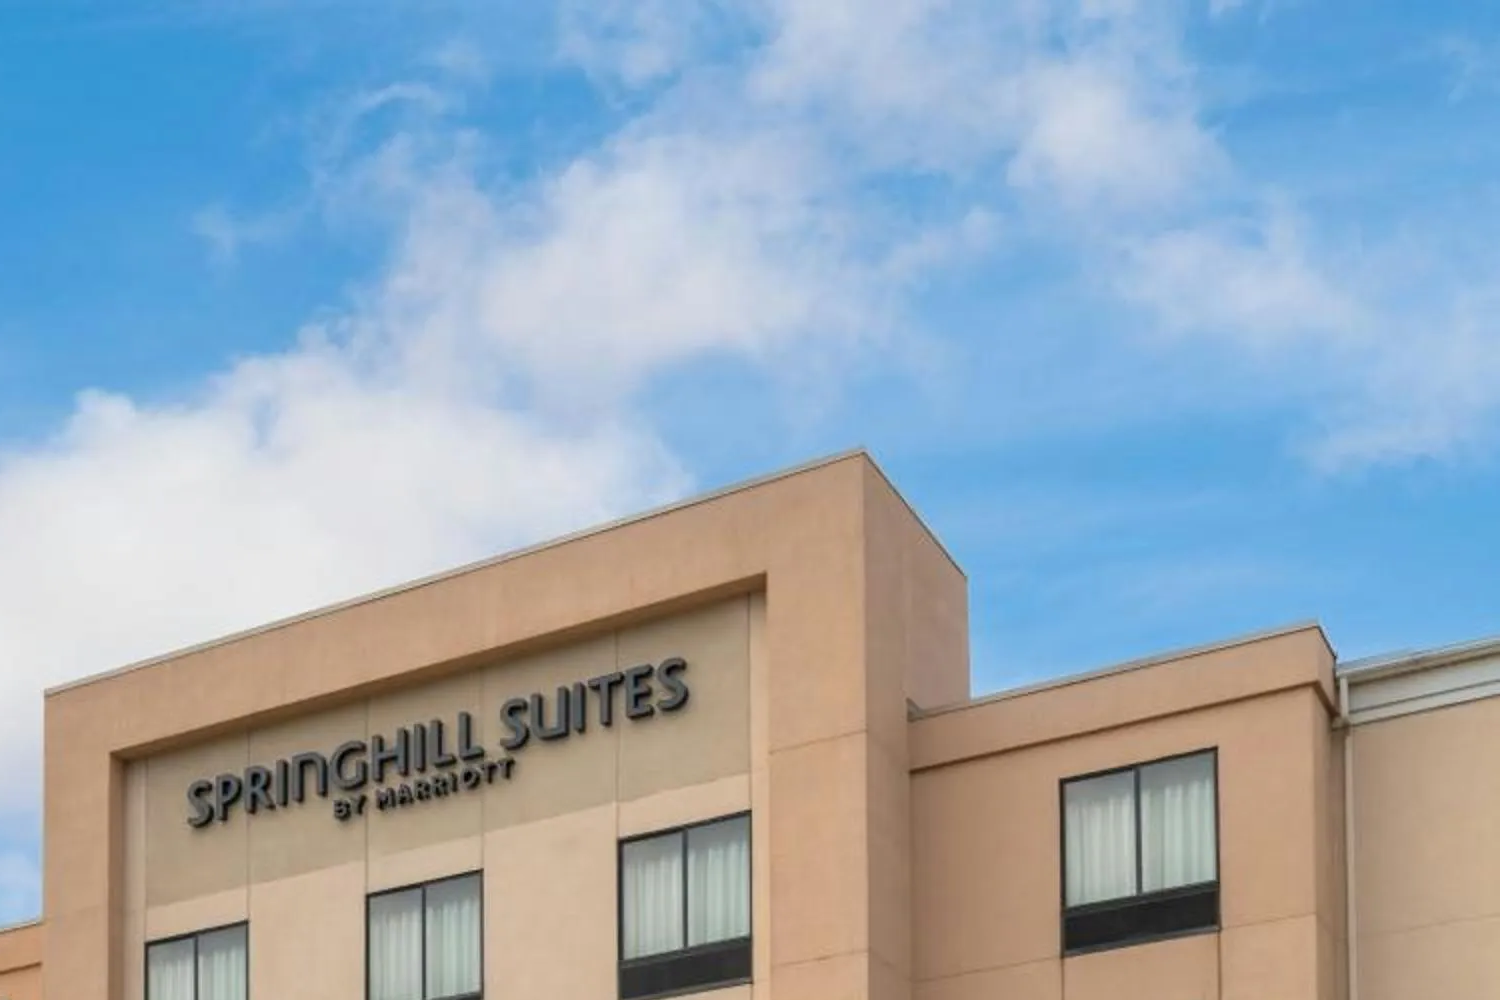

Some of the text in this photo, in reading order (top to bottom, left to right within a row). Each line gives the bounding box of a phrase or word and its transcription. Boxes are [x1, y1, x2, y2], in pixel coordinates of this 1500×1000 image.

[187, 657, 689, 828] SPRINGHILL SUITES
[333, 758, 515, 821] BY MARRIOTT
